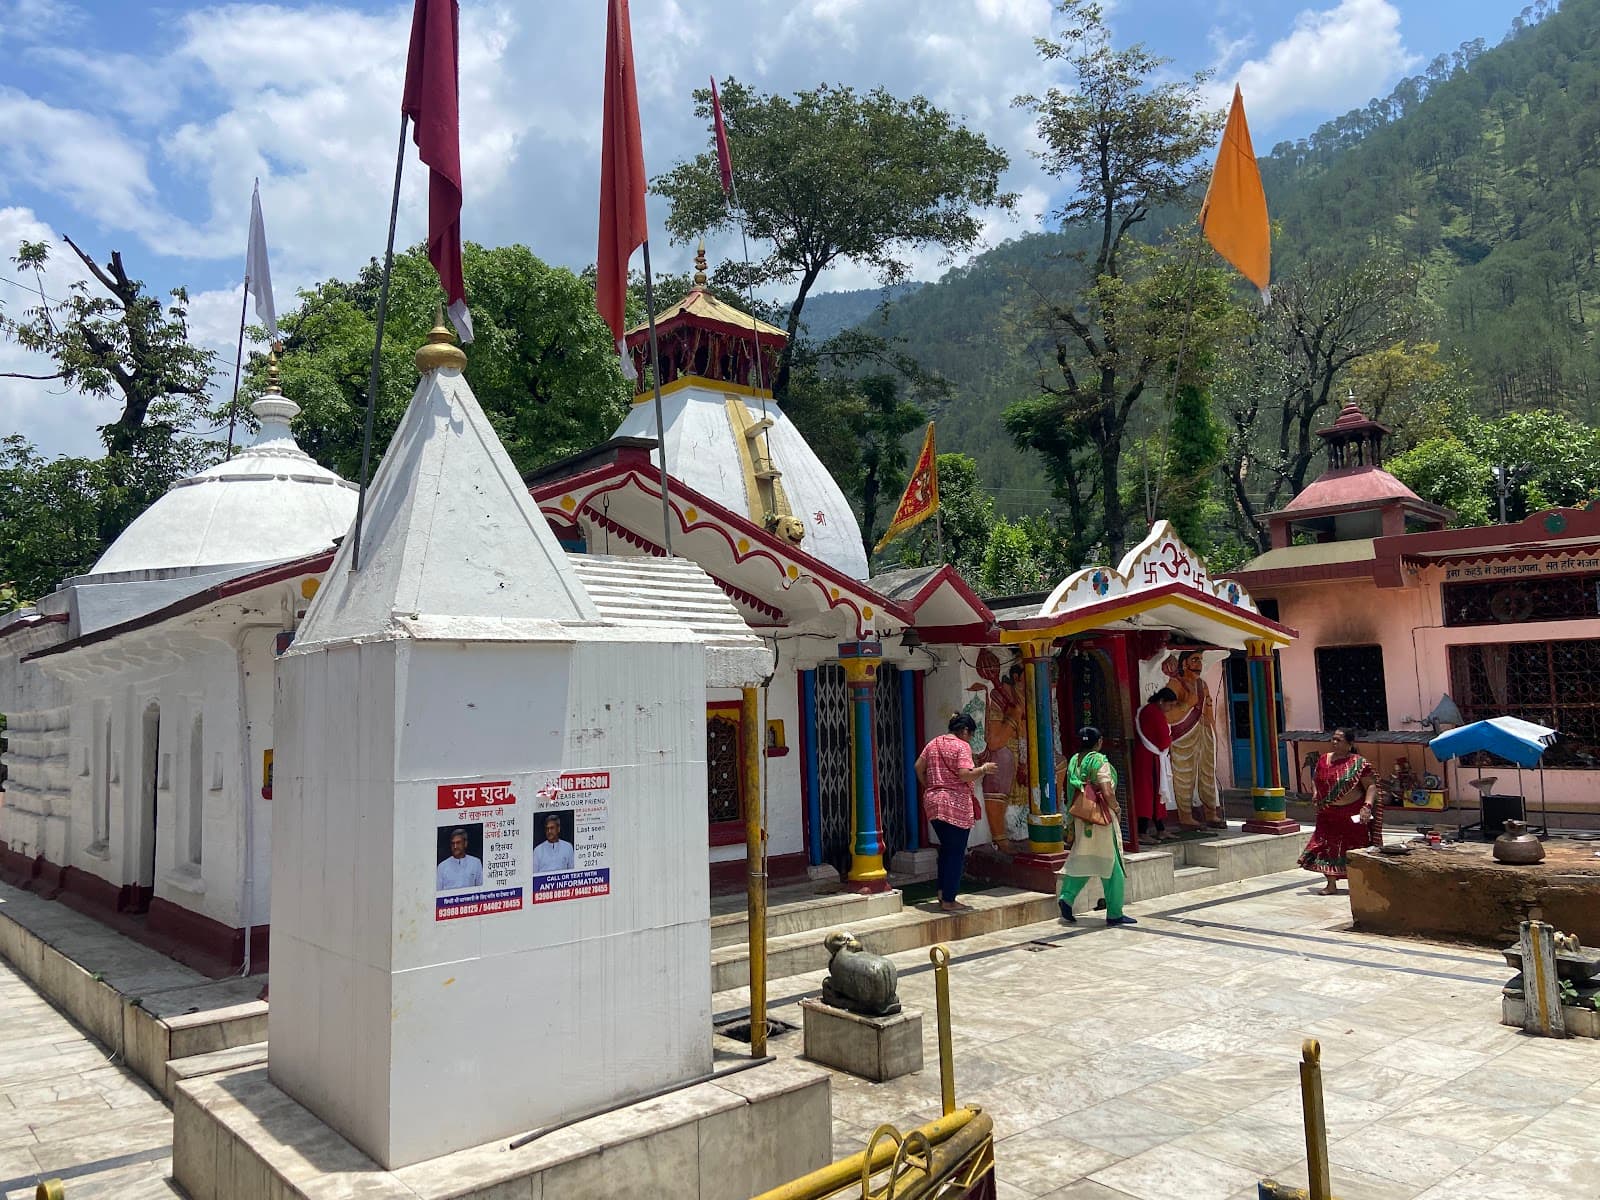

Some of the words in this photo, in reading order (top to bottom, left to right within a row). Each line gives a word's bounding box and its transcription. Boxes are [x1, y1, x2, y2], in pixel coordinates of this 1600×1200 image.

[576, 776, 608, 790] PERSON
[453, 788, 478, 806] गुम
[480, 786, 509, 804] शुदा
[469, 811, 493, 821] सुकुमार
[496, 808, 504, 816] जी
[576, 842, 607, 851] Devprayag
[540, 882, 556, 891] ANY
[557, 876, 604, 889] INFORMATION
